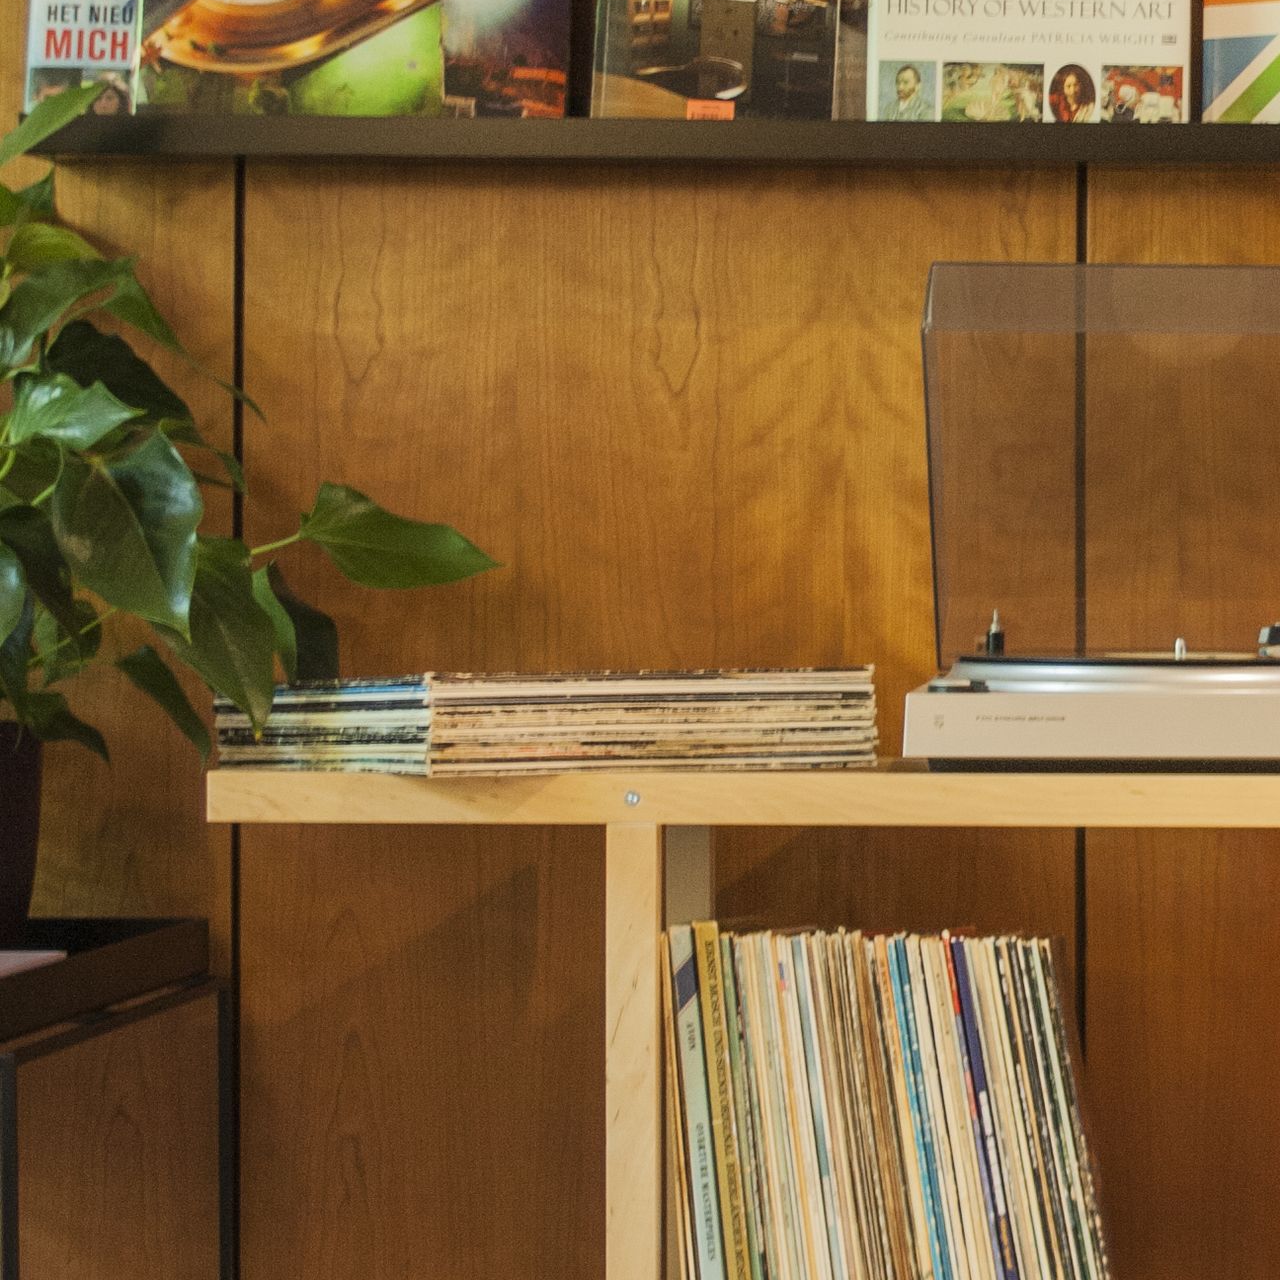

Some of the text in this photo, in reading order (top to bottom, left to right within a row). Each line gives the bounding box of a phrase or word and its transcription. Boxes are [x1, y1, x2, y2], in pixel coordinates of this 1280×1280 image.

[47, 5, 80, 22] HET
[1018, 0, 1128, 20] WESTERN
[1132, 1, 1177, 20] ART
[44, 27, 129, 61] MICH
[882, 29, 959, 44] Contributing
[962, 30, 1028, 43] Consultant
[1029, 31, 1094, 46] PATRICIA
[1097, 33, 1156, 47] WRIGHT
